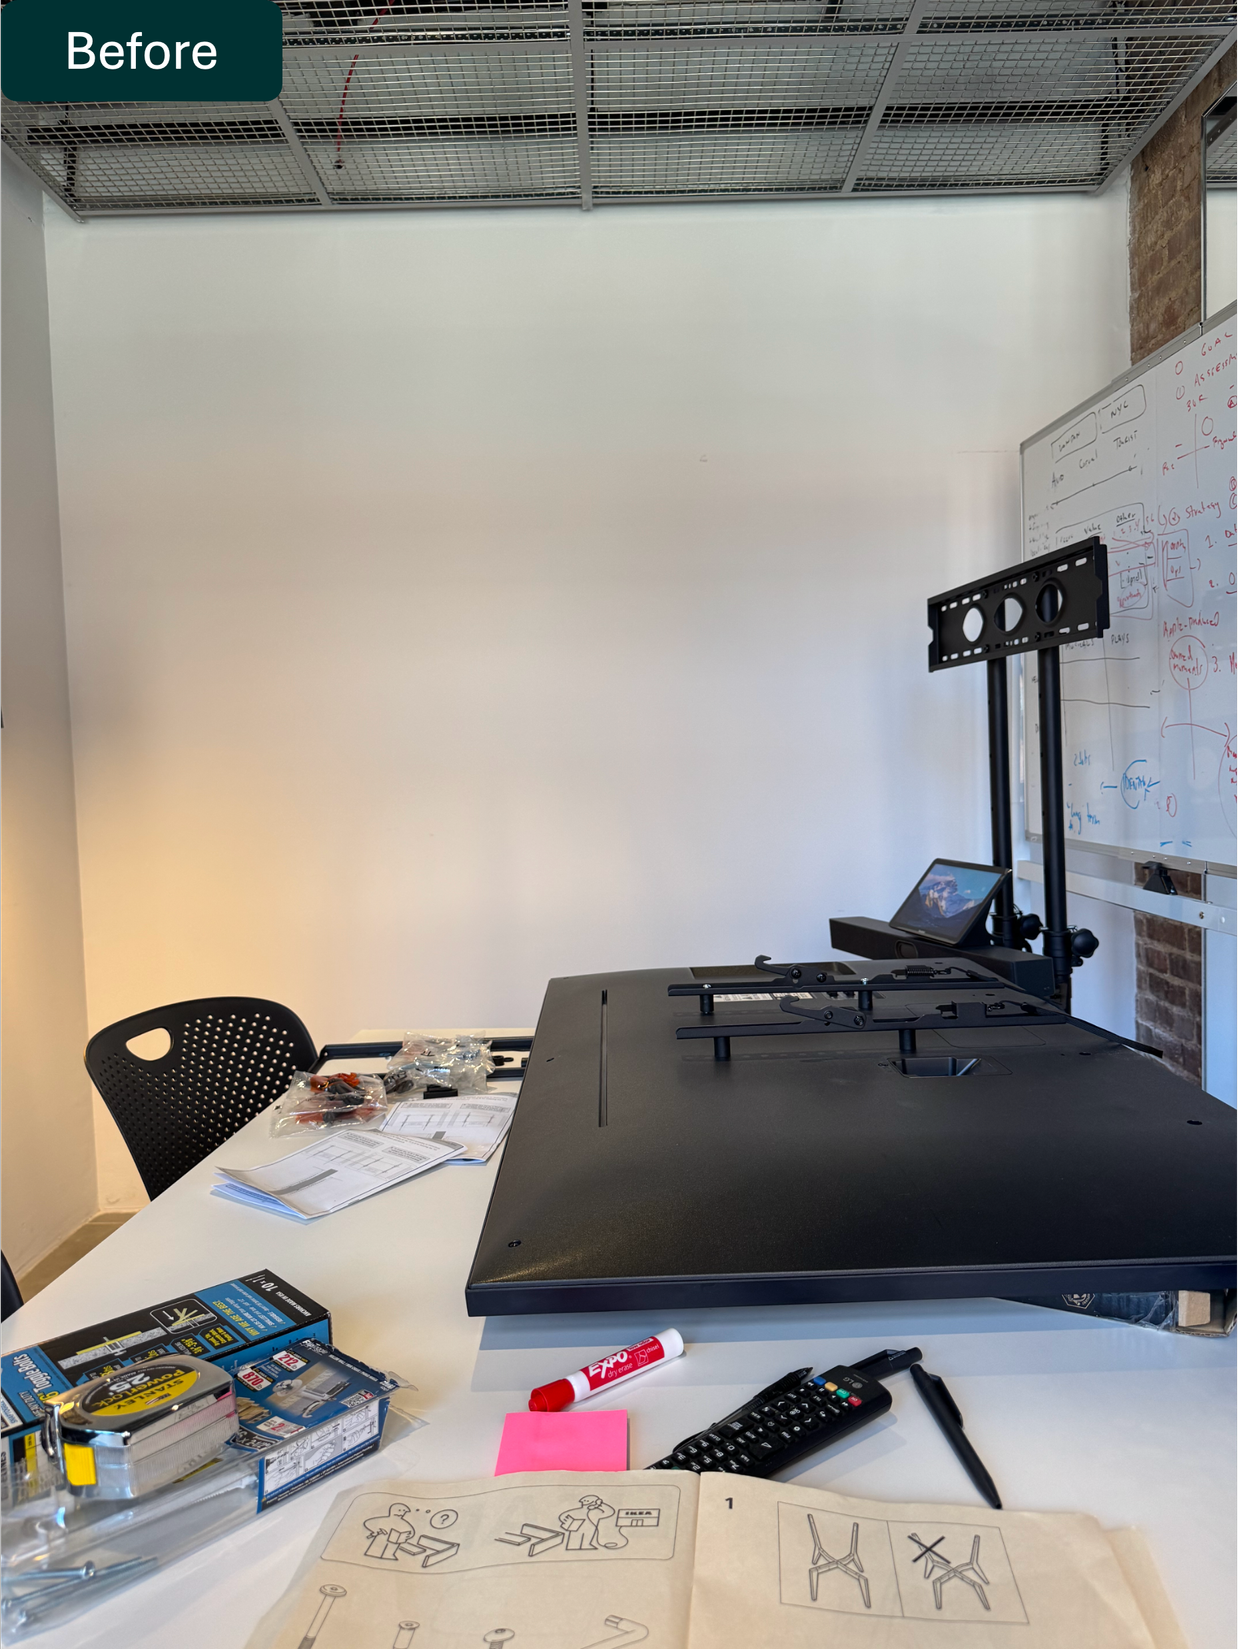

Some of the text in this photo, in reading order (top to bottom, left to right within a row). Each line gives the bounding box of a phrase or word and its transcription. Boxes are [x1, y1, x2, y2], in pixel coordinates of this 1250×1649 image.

[646, 1344, 660, 1354] chisel
[13, 1354, 36, 1373] Bolts
[278, 1354, 299, 1366] 212
[588, 1351, 628, 1379] EXPO
[608, 1363, 633, 1378] dry erase
[24, 1368, 52, 1393] Toggle
[242, 1372, 264, 1386] 870
[843, 1376, 854, 1384] LG
[115, 1378, 184, 1410] STANLEY
[725, 1498, 734, 1510] 1
